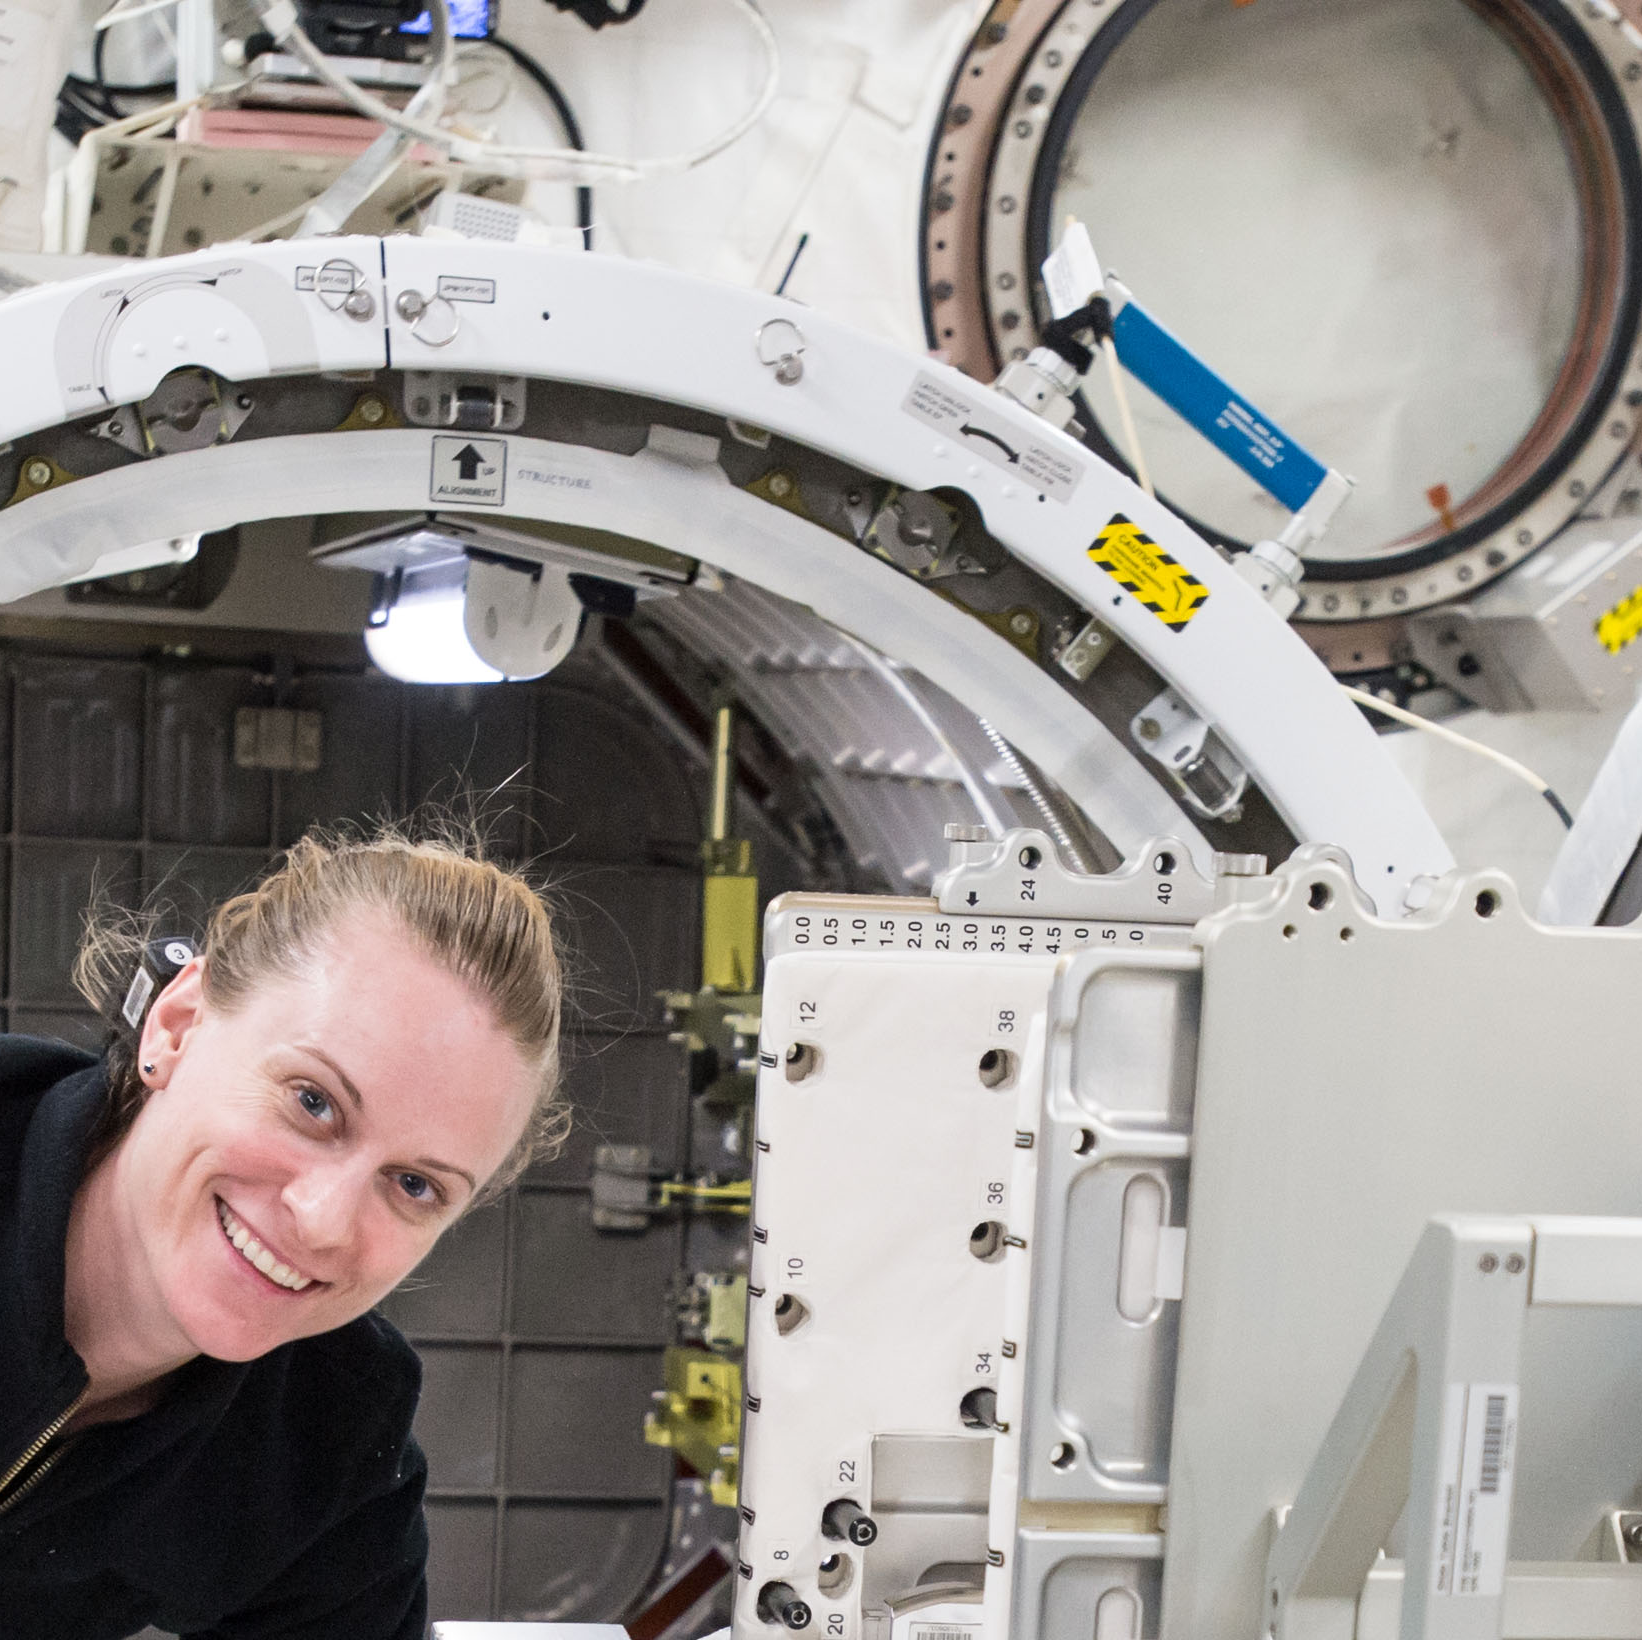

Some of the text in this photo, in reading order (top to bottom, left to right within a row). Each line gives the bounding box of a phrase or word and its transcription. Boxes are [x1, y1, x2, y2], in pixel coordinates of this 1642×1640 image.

[437, 485, 498, 497] ALIGNMENT
[518, 469, 592, 489] STRUCTURE
[1118, 534, 1158, 570] CAUTION
[1020, 879, 1035, 900] 24
[1157, 882, 1172, 905] 40
[795, 916, 810, 945] 0.0
[823, 917, 839, 946] 0.5
[852, 918, 867, 946] 1.0
[880, 919, 895, 946] 1.5
[907, 920, 923, 949] 2.0
[935, 922, 951, 950] 2.5
[963, 923, 978, 951] 3.0
[991, 924, 1006, 952] 3.5
[1018, 926, 1034, 953] 4.0
[1046, 927, 1061, 954] 4.5
[800, 1001, 816, 1022] 12
[999, 1010, 1014, 1033] 38
[987, 1181, 1005, 1204] 36
[786, 1257, 803, 1279] 10
[976, 1352, 993, 1374] 34
[839, 1458, 856, 1483] 22
[774, 1548, 789, 1561] 8
[828, 1612, 844, 1635] 20
